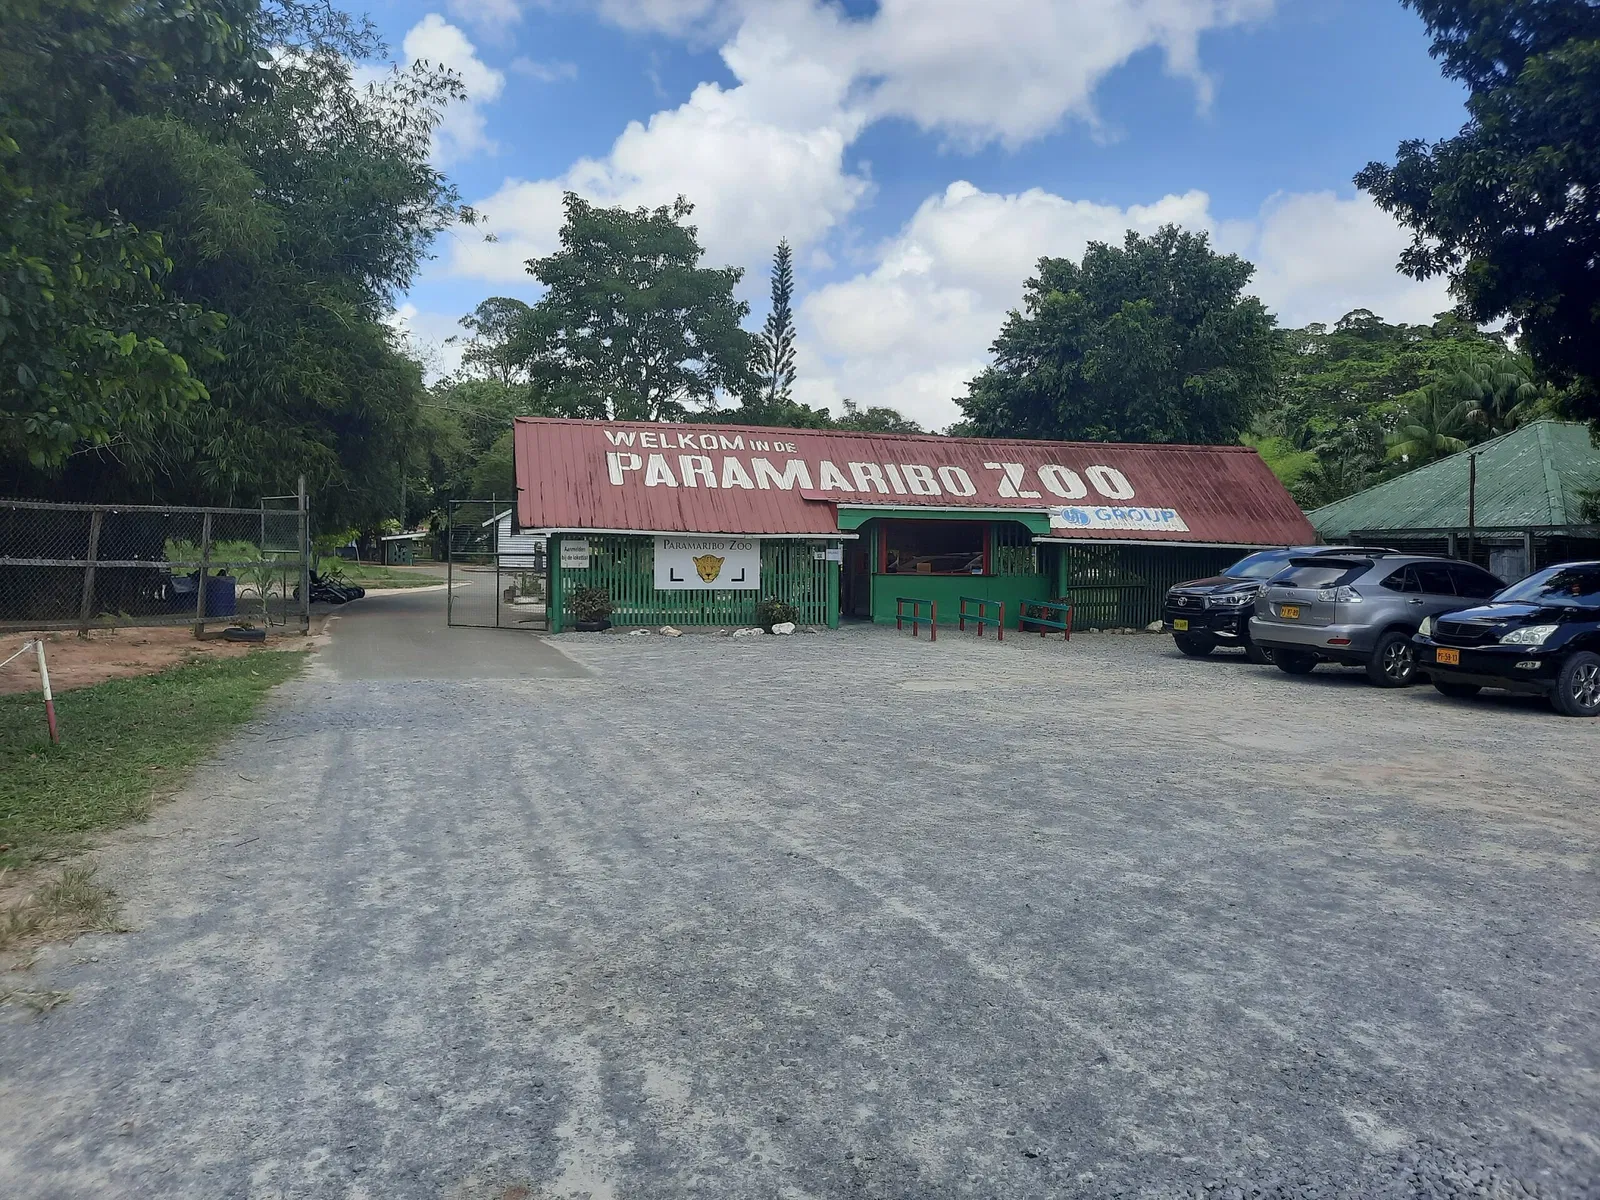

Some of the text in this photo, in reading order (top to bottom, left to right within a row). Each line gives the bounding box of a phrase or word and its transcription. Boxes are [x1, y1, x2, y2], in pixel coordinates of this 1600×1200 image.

[603, 429, 798, 454] WELKOM IN DE
[605, 451, 1136, 500] PARAMARIBO ZOO
[1094, 507, 1175, 523] GROUP
[663, 539, 753, 551] PARAMARIBO ZOO
